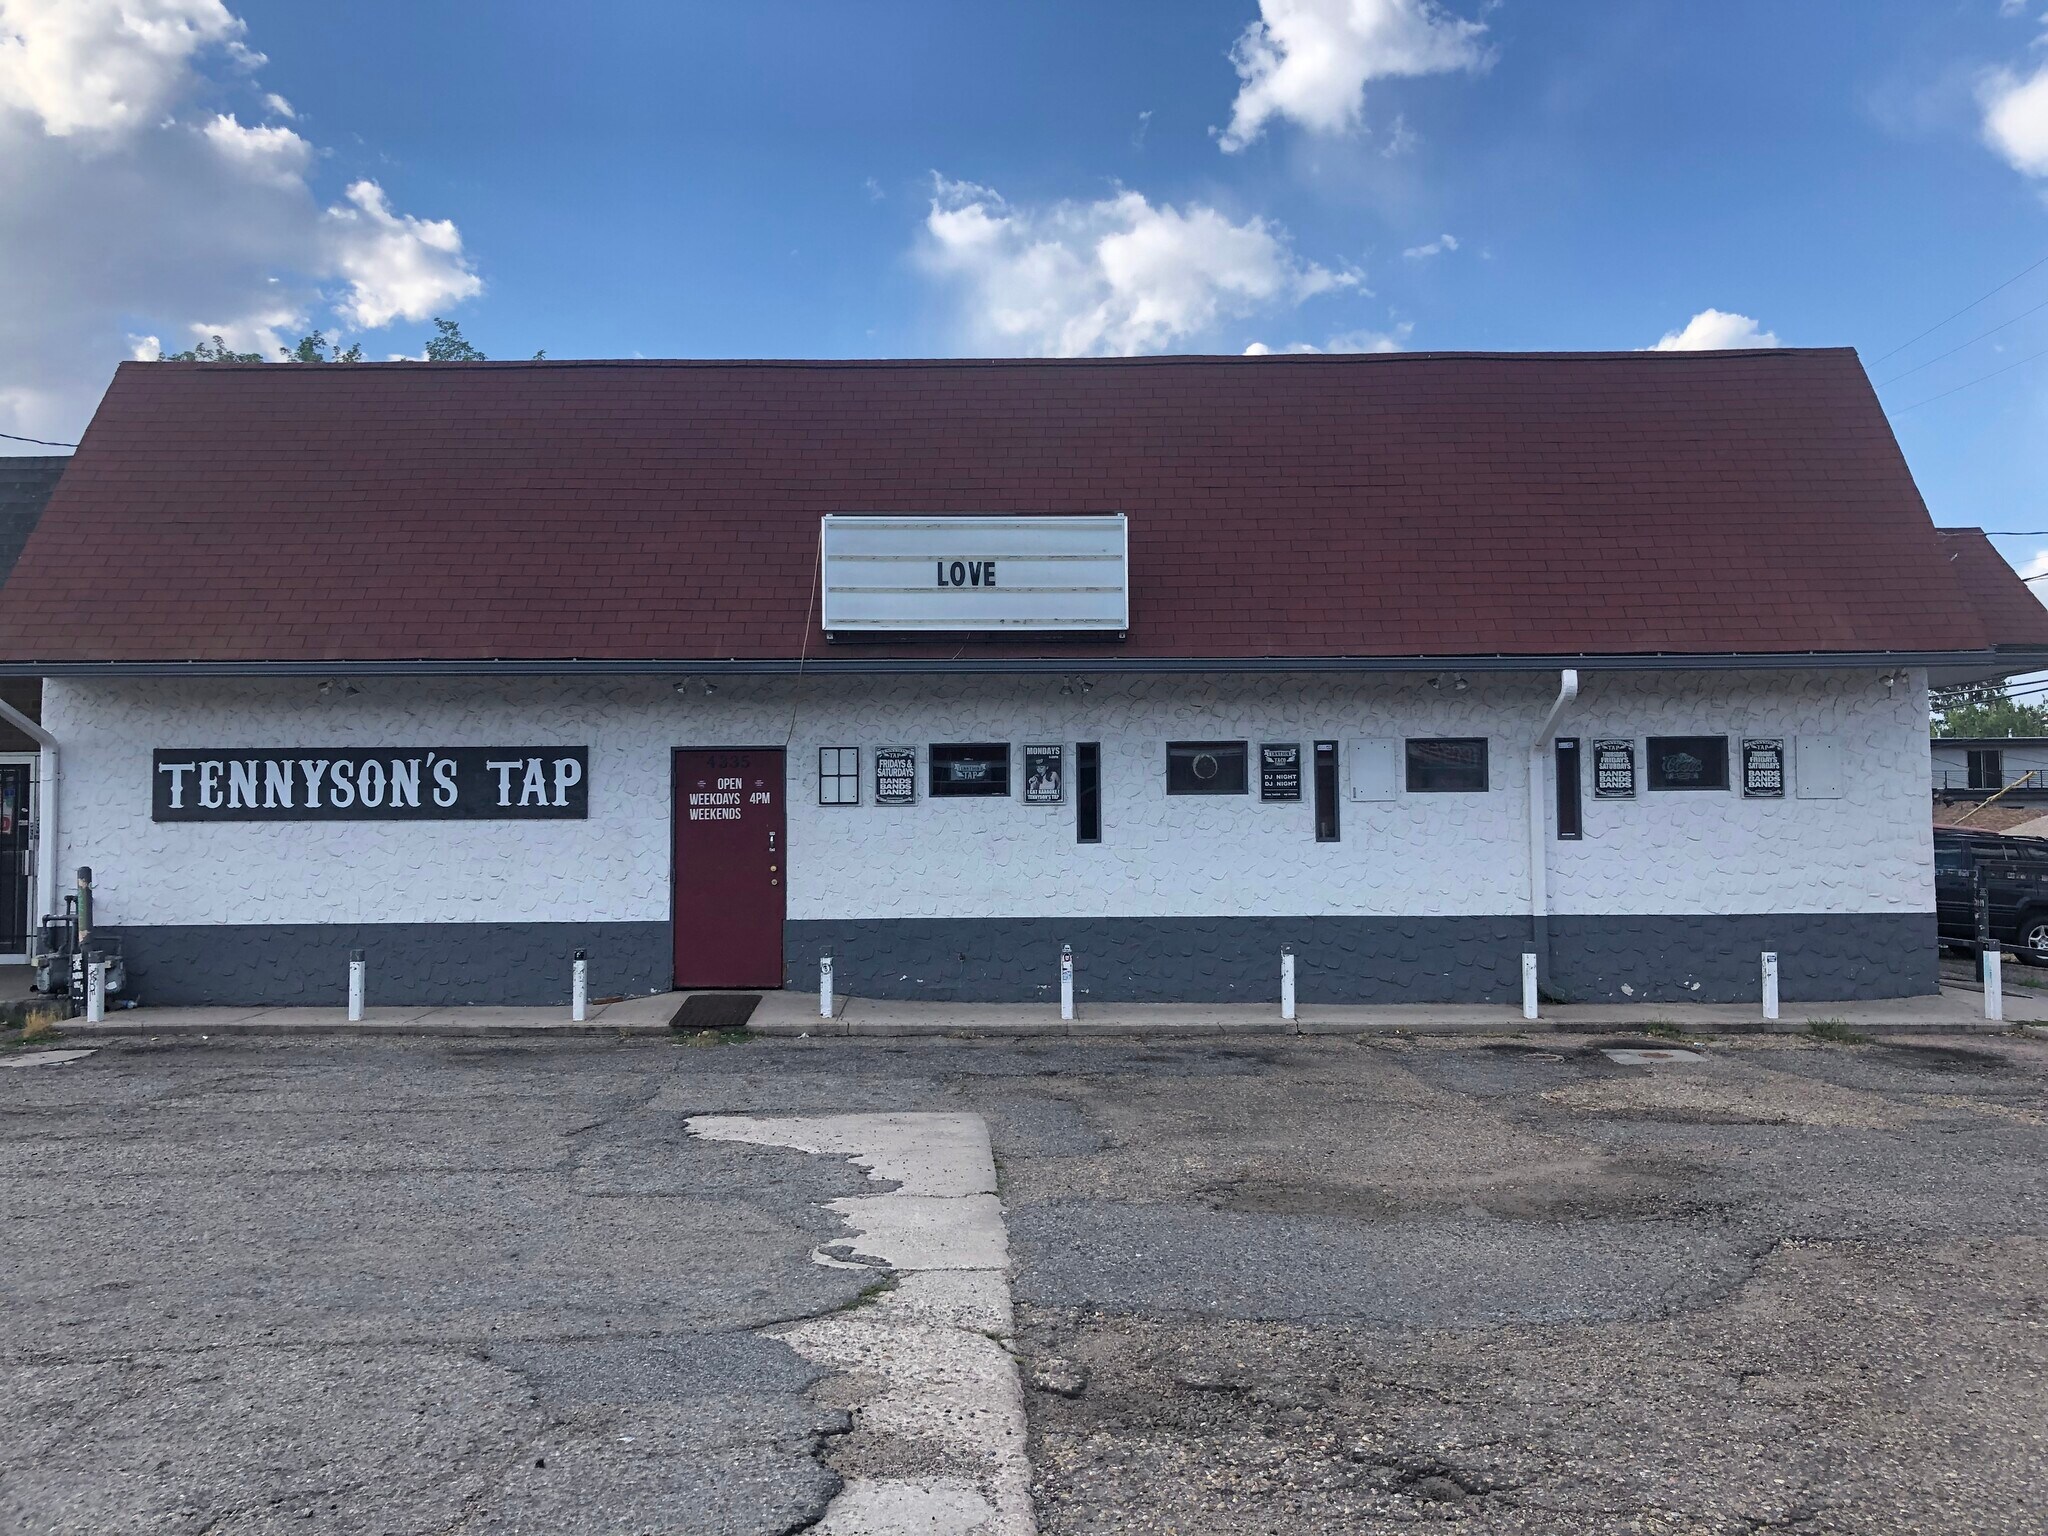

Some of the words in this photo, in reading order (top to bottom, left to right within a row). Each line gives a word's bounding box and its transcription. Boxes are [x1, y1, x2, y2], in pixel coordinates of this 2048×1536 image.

[937, 561, 996, 587] LOVE
[1026, 747, 1061, 755] MONDAYS
[879, 759, 906, 768] FRIDAYS
[906, 759, 913, 768] &
[877, 768, 914, 777] SATURDAYS
[963, 771, 978, 780] TAP
[158, 752, 459, 809] TENNYSON'S
[486, 757, 582, 807] TAP
[717, 777, 743, 790] OPEN
[689, 792, 741, 806] WEEKDAYS
[749, 792, 771, 804] 4PM
[689, 807, 742, 821] WEEKENDS
